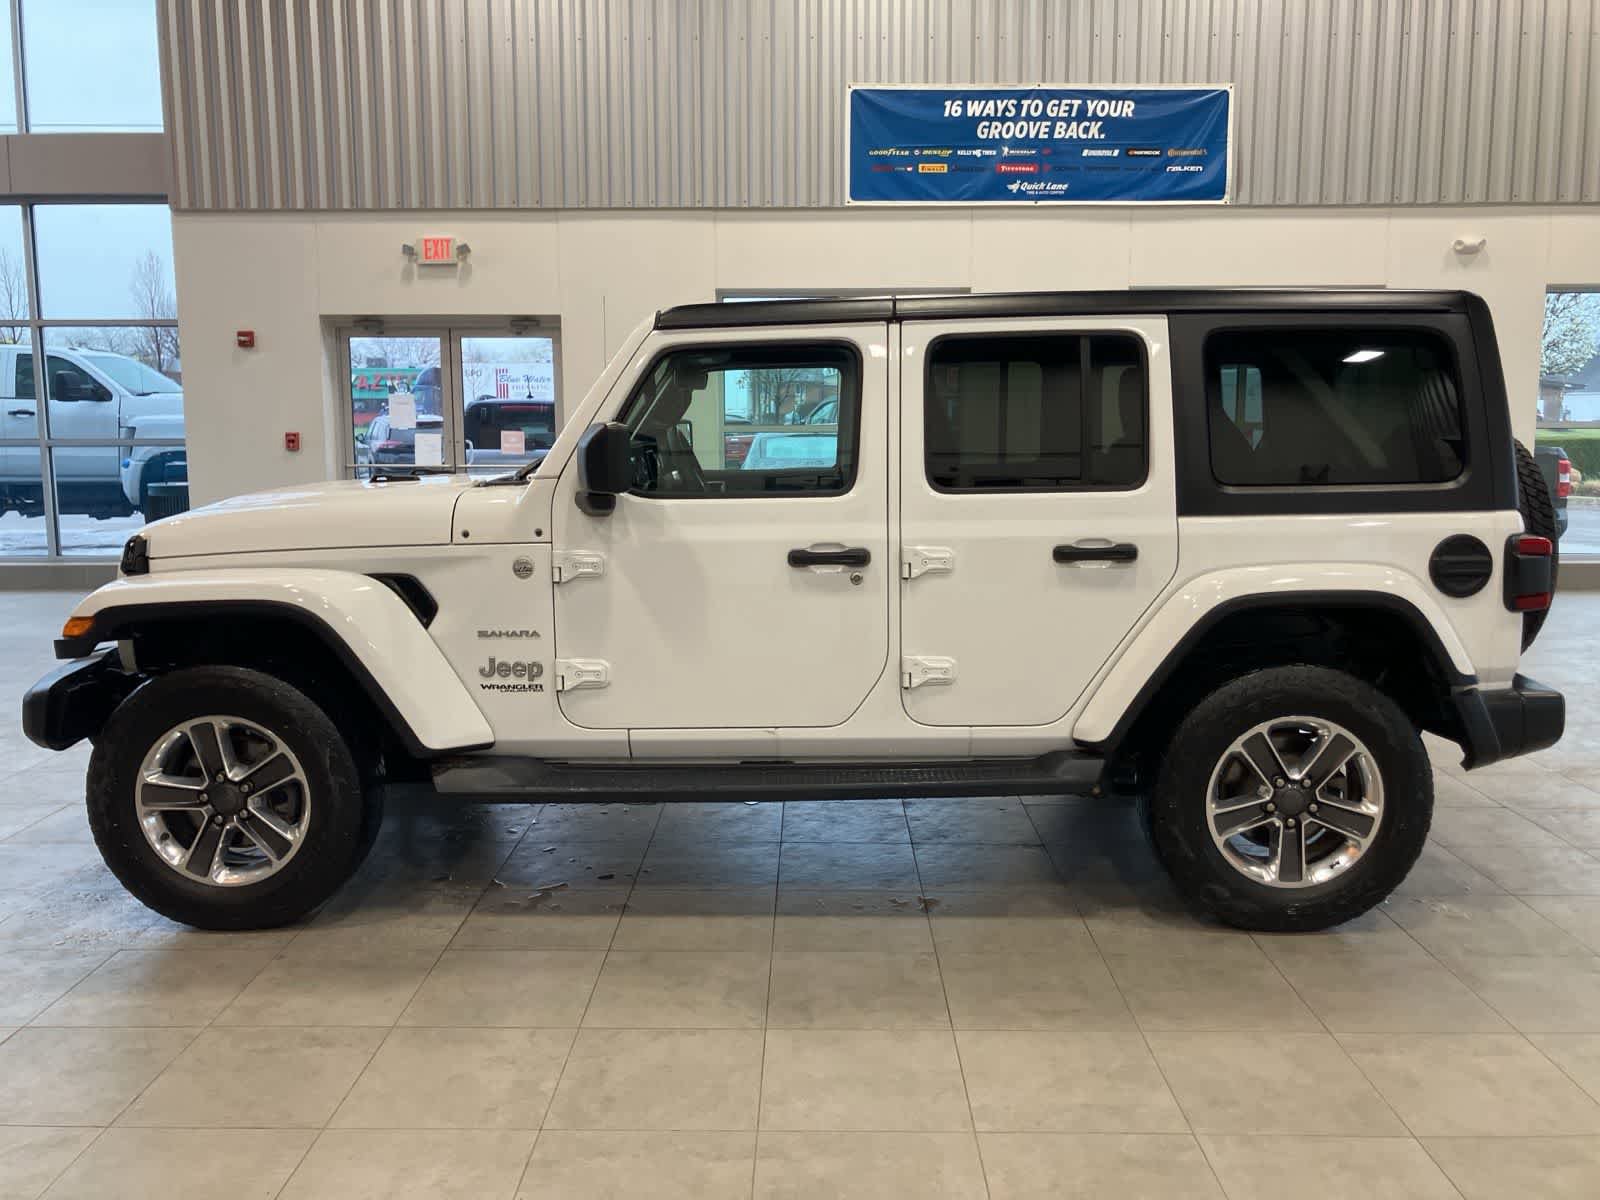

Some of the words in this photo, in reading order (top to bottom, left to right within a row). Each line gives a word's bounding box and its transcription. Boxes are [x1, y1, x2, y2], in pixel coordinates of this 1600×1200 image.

[943, 100, 962, 117] 16
[966, 99, 1017, 117] WAYS
[1020, 99, 1043, 117] TO
[1046, 99, 1082, 117] GET
[1086, 99, 1135, 117] YOUR
[976, 121, 1051, 139] GROOVE
[1053, 121, 1105, 139] BACK.
[1166, 165, 1203, 173] FALKEN
[1020, 181, 1045, 191] Quick
[1046, 181, 1069, 190] Lane
[423, 239, 451, 260] EXIT
[477, 630, 541, 638] SAHARA
[478, 656, 544, 681] Jeep
